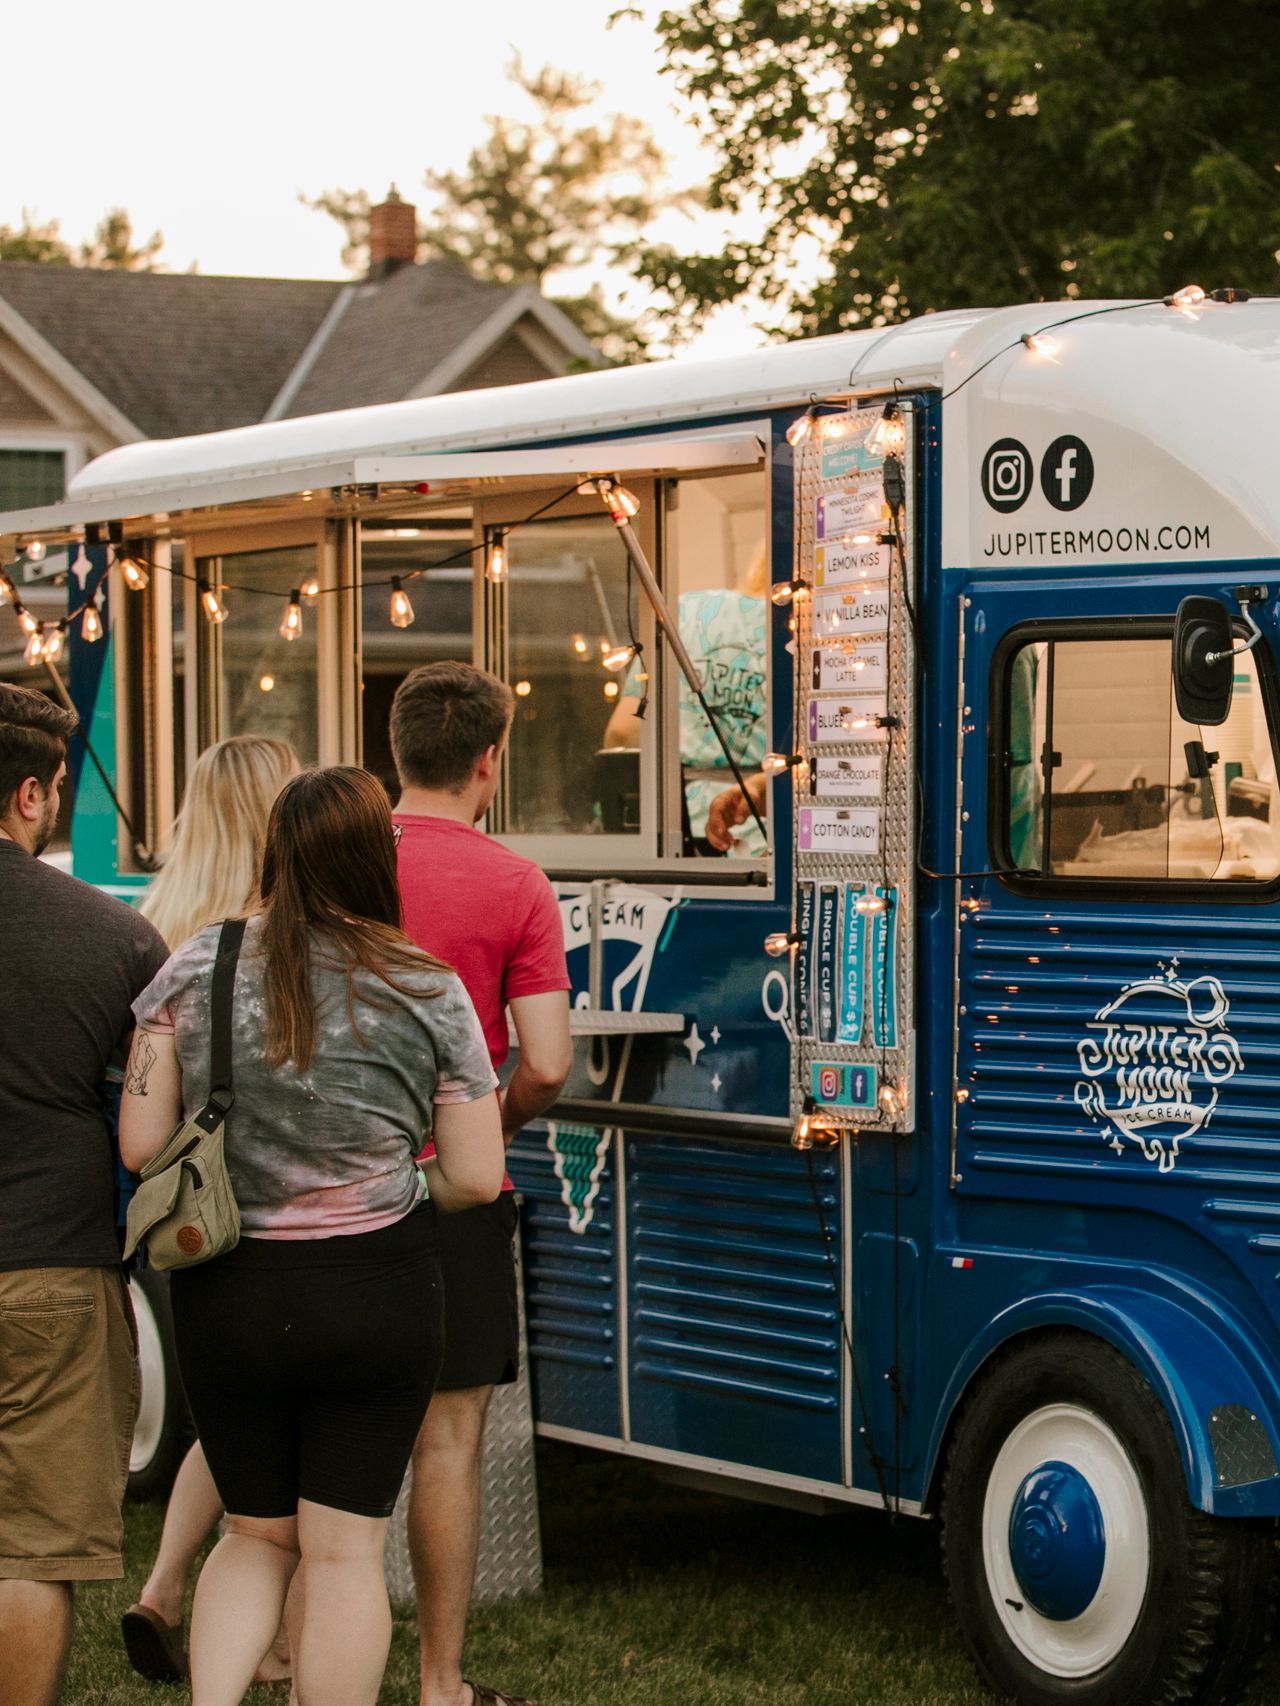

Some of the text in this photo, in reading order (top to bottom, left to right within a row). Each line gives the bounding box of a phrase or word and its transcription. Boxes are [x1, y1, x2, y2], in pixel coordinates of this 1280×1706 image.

[984, 525, 1210, 556] JUPITERMOON.COM
[828, 552, 880, 572] LEMON KISS
[863, 603, 888, 618] BEAN
[824, 657, 847, 668] MOCHA
[836, 671, 856, 682] LATTE
[843, 769, 880, 780] CHOCOLATE
[813, 823, 876, 838] COTTON CANDY
[822, 899, 833, 962] SINGLE
[847, 892, 860, 965] DOUBLE
[822, 967, 831, 1002] CUP
[848, 970, 857, 1006] CUP
[1116, 1066, 1192, 1108] MOON
[1121, 1106, 1192, 1124] ICE CREAM
